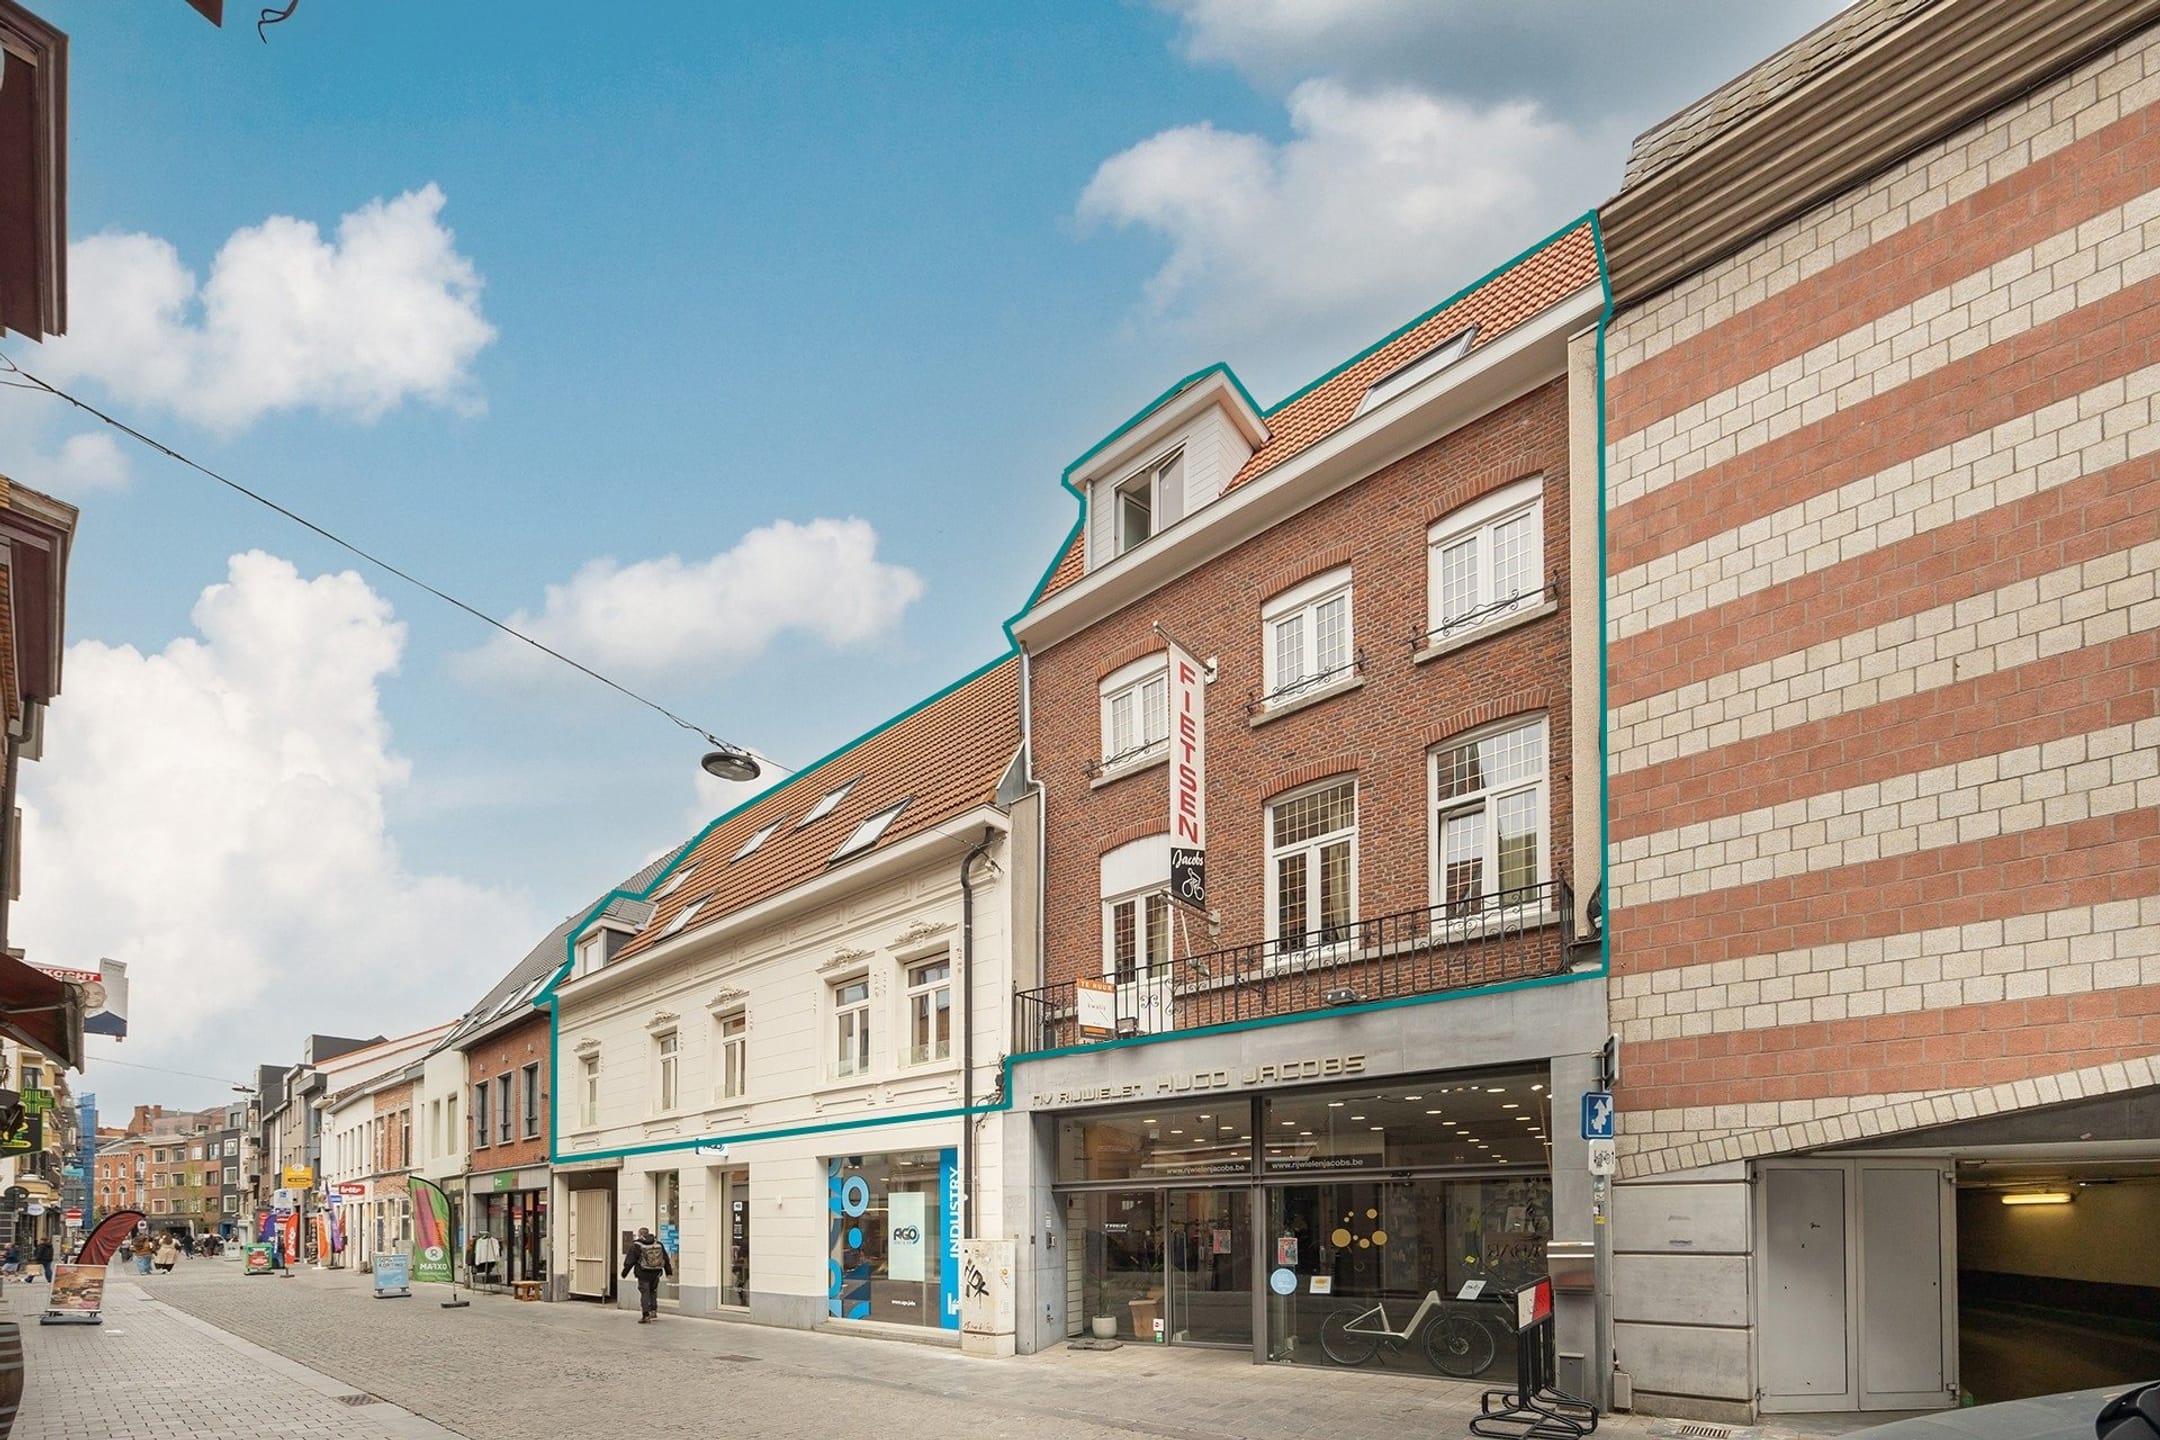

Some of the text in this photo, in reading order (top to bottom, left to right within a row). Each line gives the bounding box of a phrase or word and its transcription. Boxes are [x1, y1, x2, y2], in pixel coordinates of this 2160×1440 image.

[1178, 660, 1199, 845] FIETSEN
[1172, 849, 1204, 869] Jacobs
[38, 969, 97, 982] KOCHT
[1156, 1070, 1230, 1094] HUGO
[1242, 1054, 1367, 1084] JACOBS
[1166, 1164, 1246, 1175] www.rijwielenjacobs.be
[1271, 1158, 1364, 1170] www.rijwielenjacobs.be
[950, 1166, 959, 1259] INDUSTRY
[893, 1227, 918, 1241] AGO
